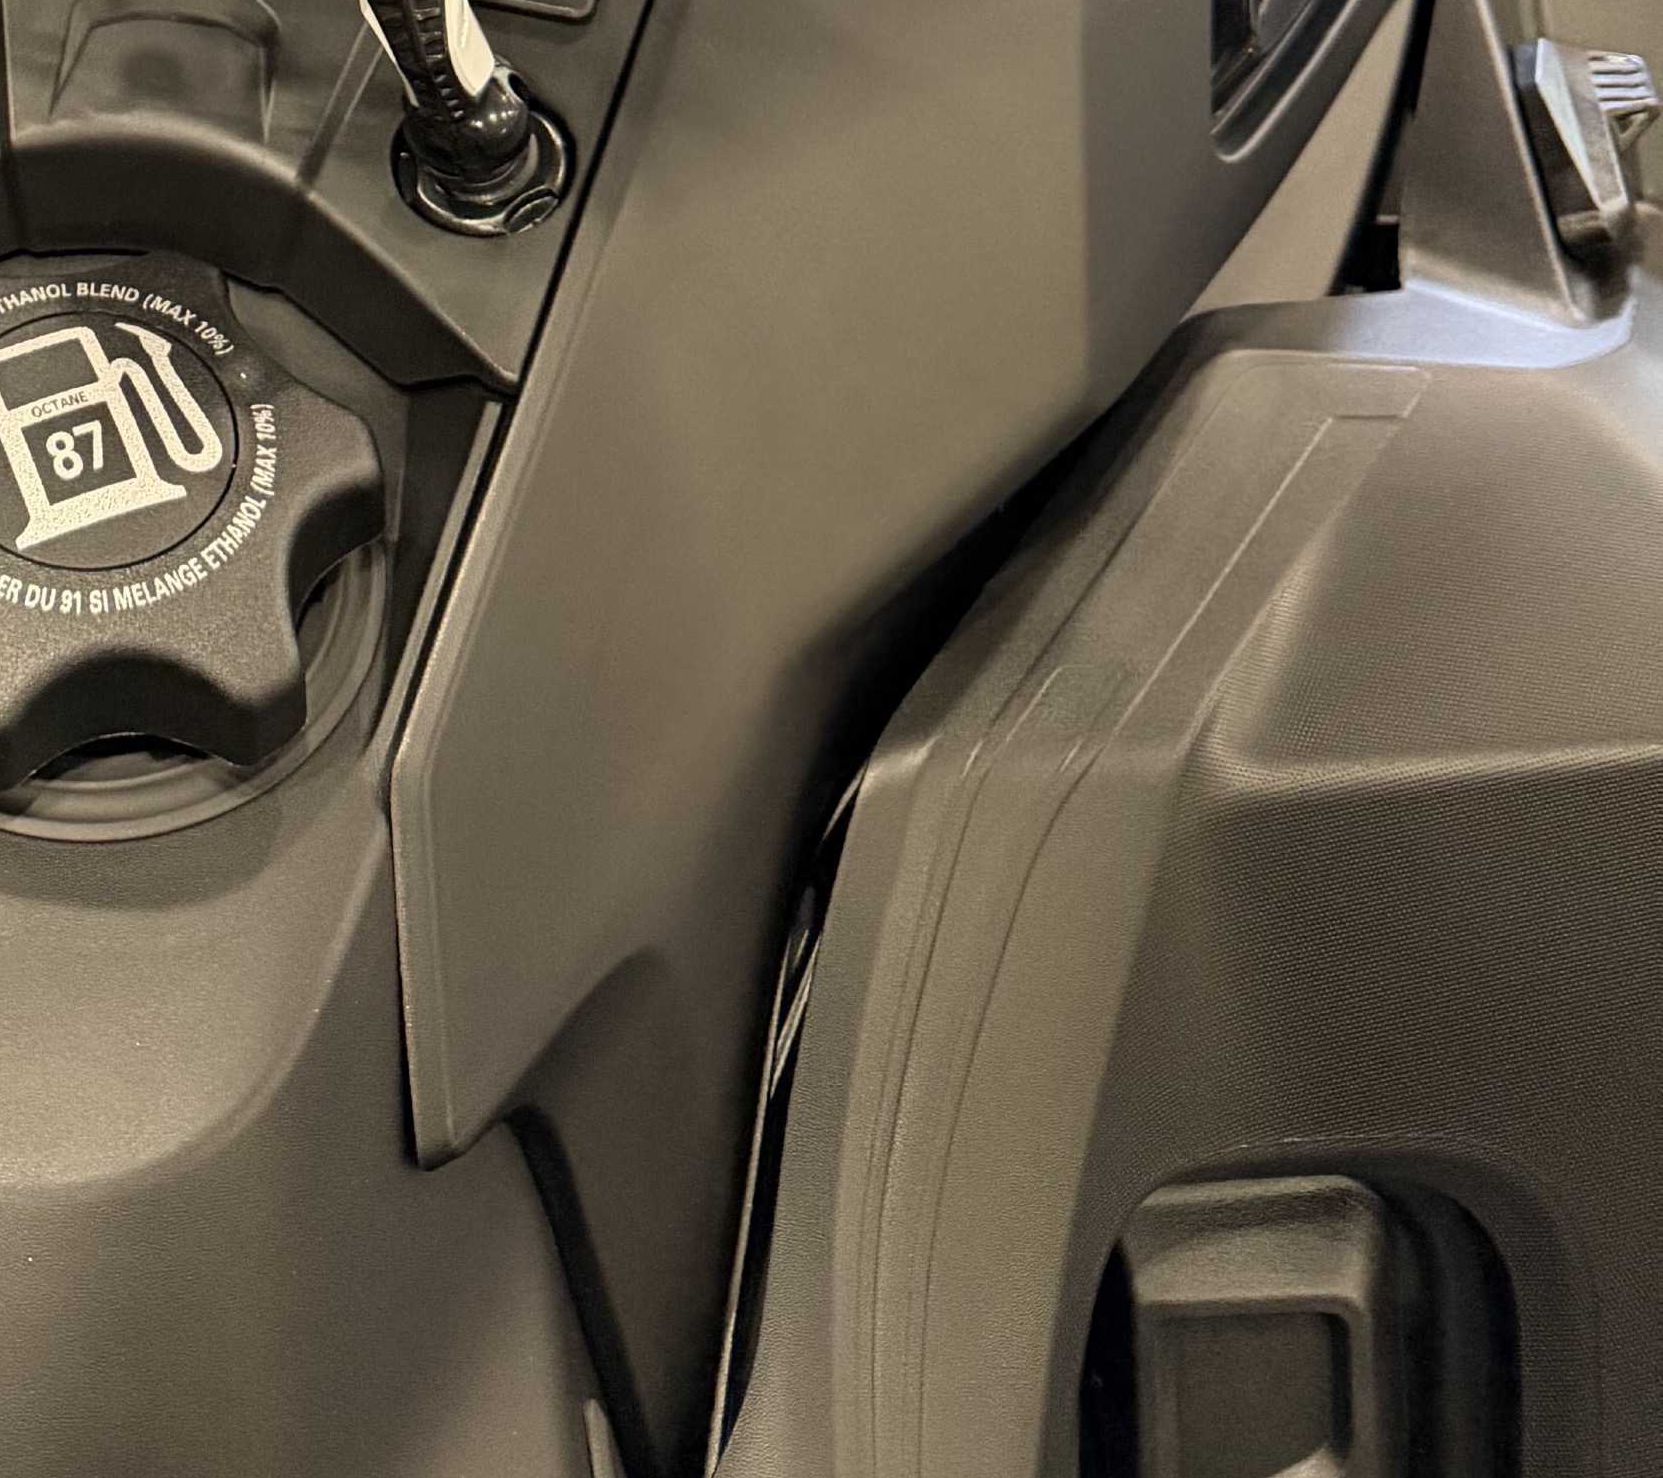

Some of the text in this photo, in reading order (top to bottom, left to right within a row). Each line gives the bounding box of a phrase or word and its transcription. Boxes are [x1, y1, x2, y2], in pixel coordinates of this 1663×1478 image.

[76, 282, 139, 302] BLEND
[142, 293, 197, 326] (MAX
[194, 321, 234, 355] 10%)
[31, 391, 89, 418] OCTANE
[249, 403, 277, 440] 10%)
[46, 420, 104, 481] 87
[250, 444, 277, 496] (MAX
[200, 495, 267, 570] ETHANOL
[24, 584, 57, 612] DU
[60, 590, 82, 615] 91
[89, 589, 109, 614] SI
[113, 557, 208, 611] MELANGE
